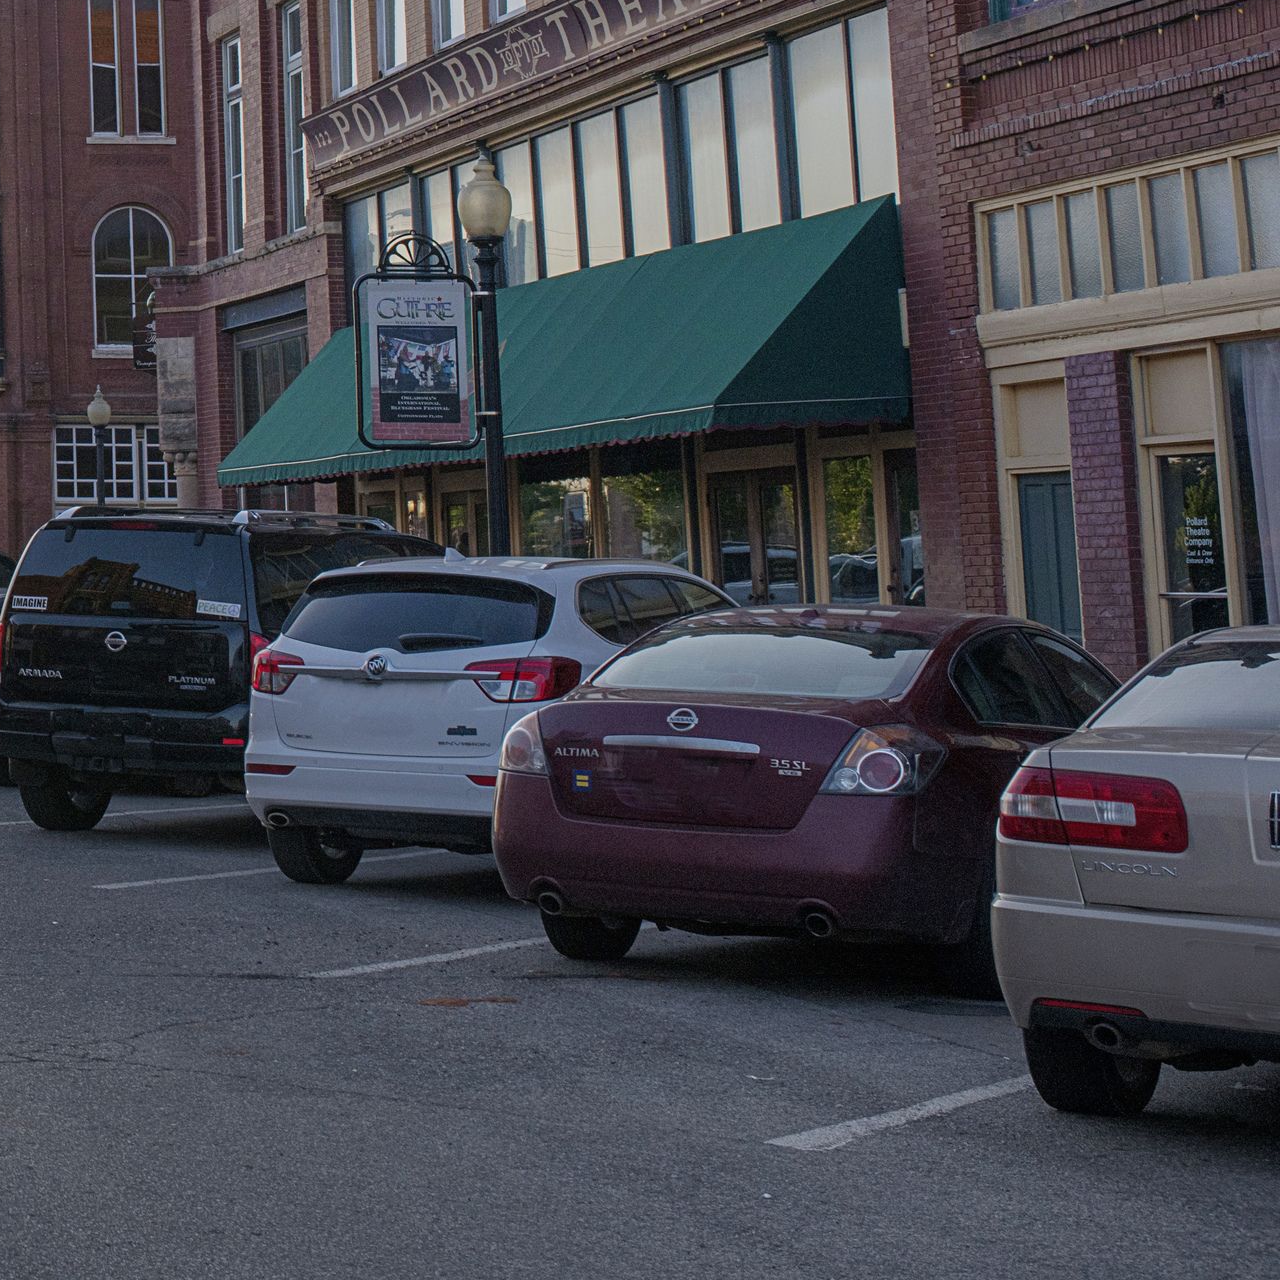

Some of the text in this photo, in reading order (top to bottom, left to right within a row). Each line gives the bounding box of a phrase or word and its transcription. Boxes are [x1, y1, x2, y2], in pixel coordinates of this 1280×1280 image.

[314, 130, 333, 149] 122
[329, 46, 498, 153] POLLARD
[376, 298, 455, 320] GUTHRIE
[1186, 515, 1208, 526] Pollard
[1185, 526, 1210, 536] Theatre
[1184, 536, 1213, 548] Company
[13, 597, 47, 608] IMAGINE
[197, 601, 228, 614] PEACE
[18, 667, 63, 680] ARMADA
[168, 675, 216, 686] PLATINUM
[554, 746, 600, 759] ALTIMA
[1081, 859, 1179, 878] LINCOLN
